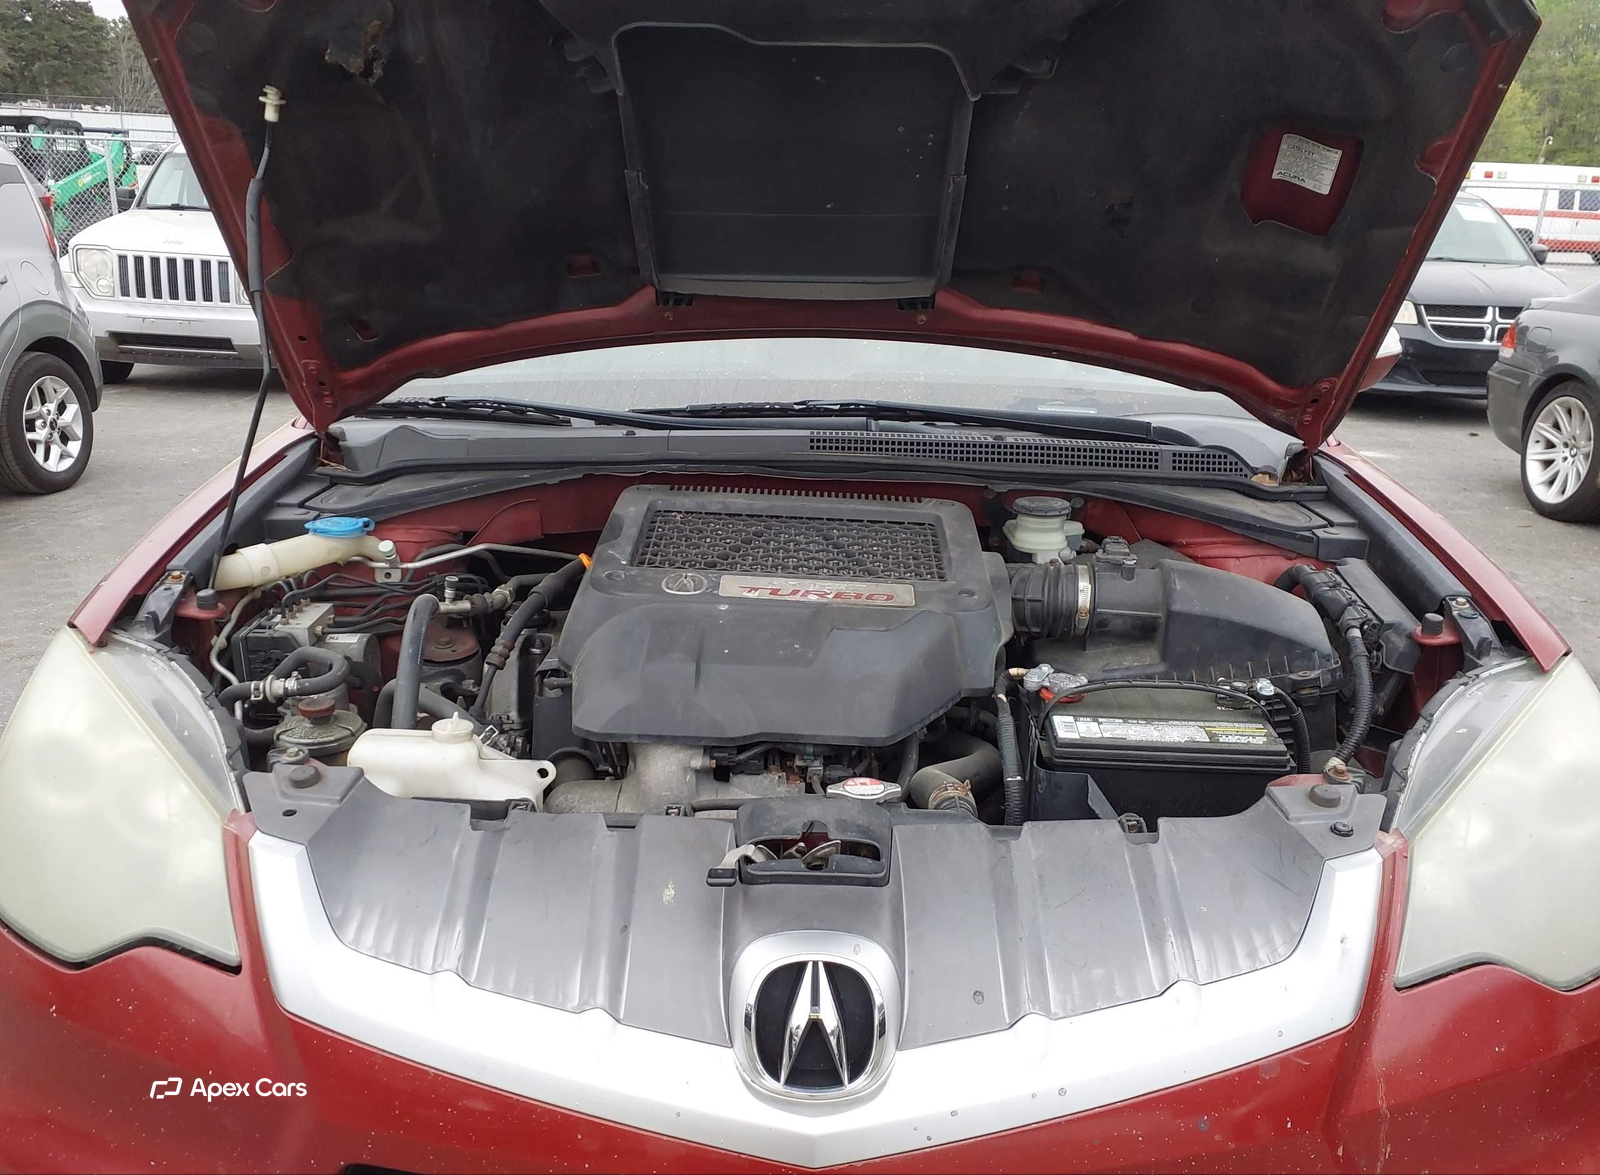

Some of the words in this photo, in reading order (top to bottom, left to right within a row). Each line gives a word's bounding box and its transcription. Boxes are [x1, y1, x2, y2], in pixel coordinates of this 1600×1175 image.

[1287, 144, 1315, 157] CATALYST
[1276, 171, 1306, 183] ACURA
[738, 586, 897, 602] TURBO
